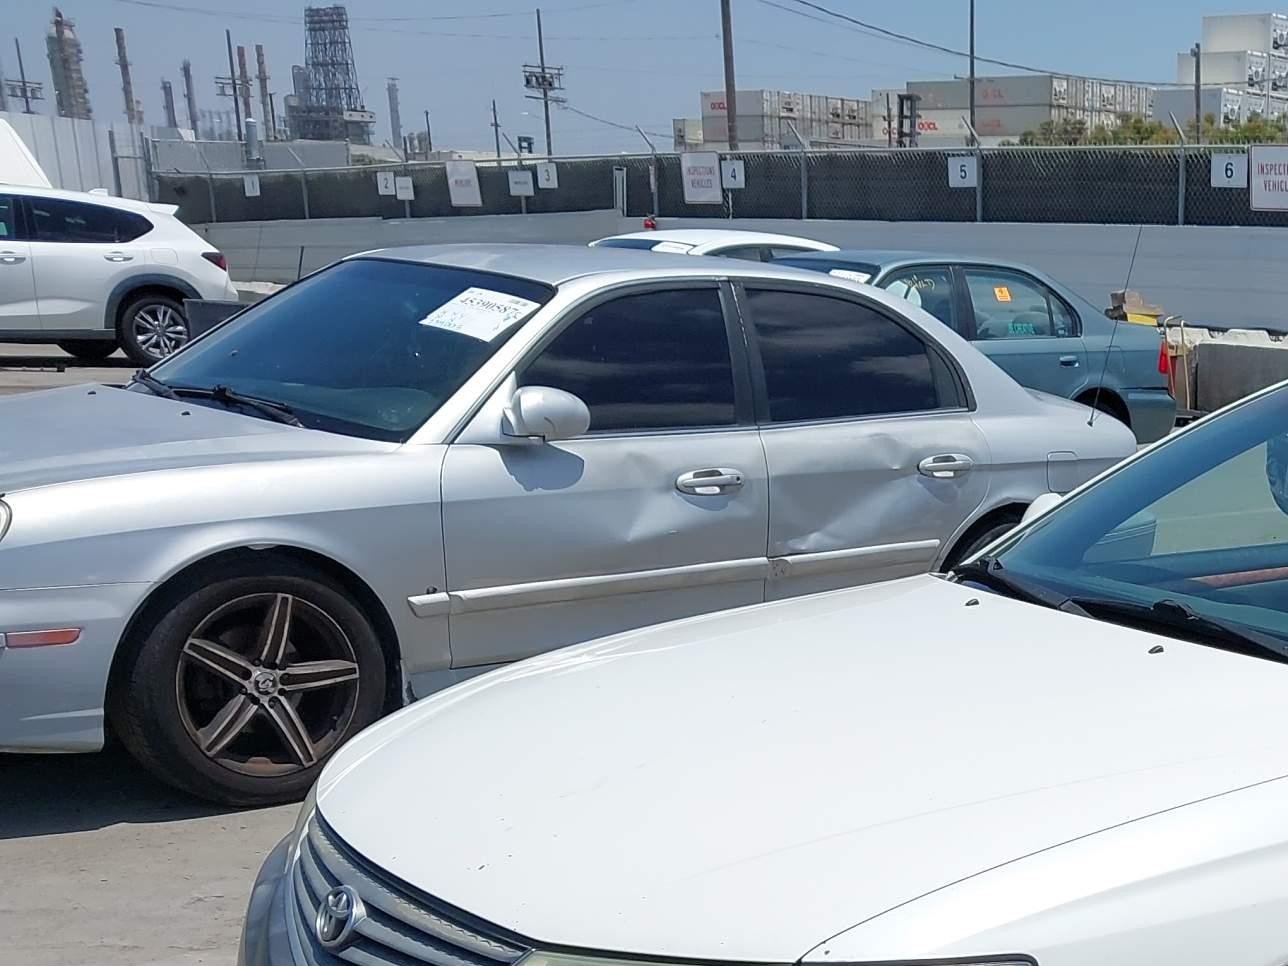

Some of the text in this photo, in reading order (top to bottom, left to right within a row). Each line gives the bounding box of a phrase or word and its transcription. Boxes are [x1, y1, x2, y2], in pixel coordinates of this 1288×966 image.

[544, 168, 551, 182] 3
[730, 167, 737, 181] 4
[960, 164, 967, 180] 5
[1224, 162, 1234, 179] 6
[383, 177, 389, 189] 2
